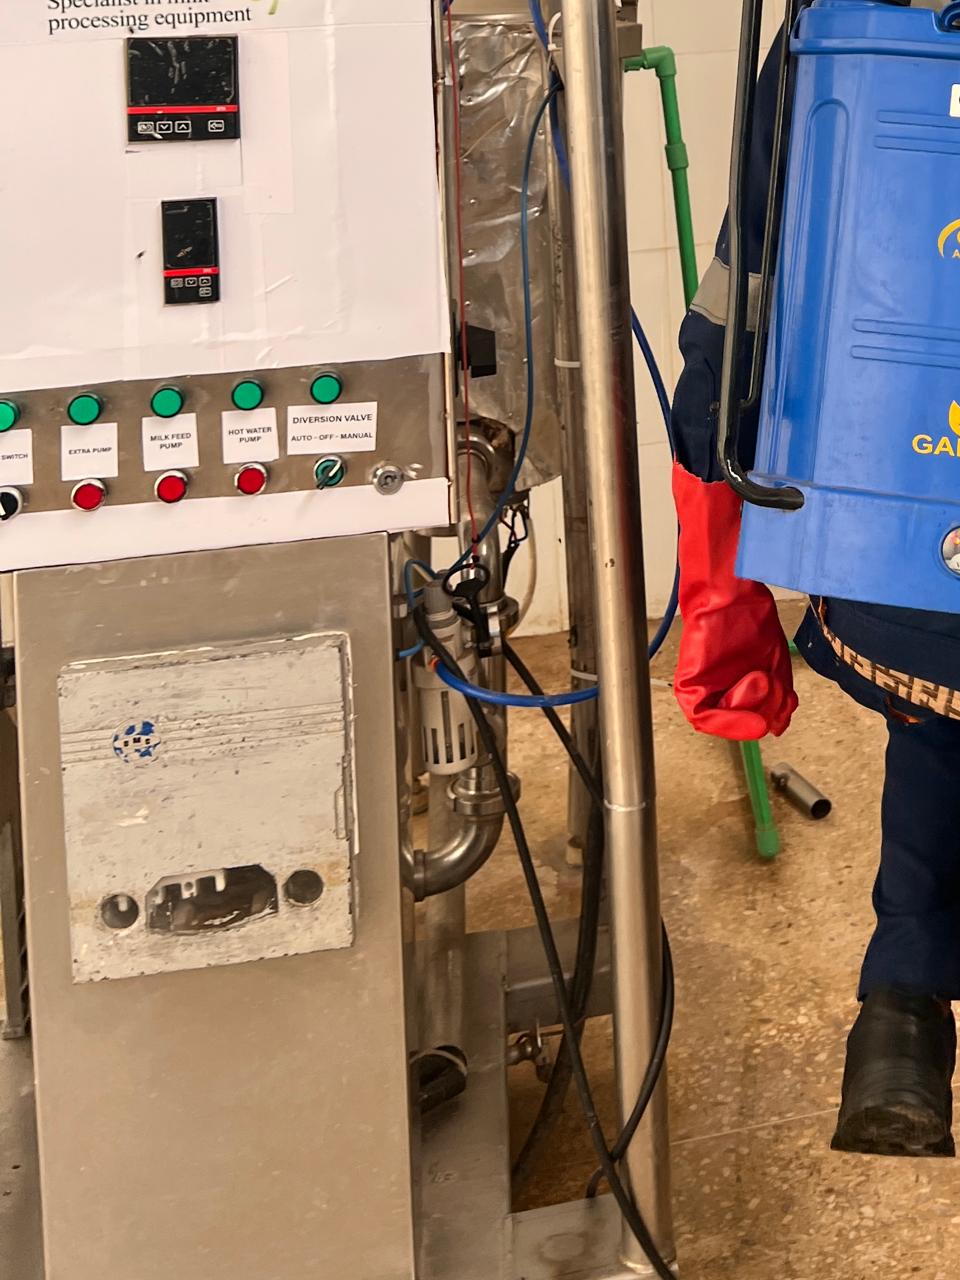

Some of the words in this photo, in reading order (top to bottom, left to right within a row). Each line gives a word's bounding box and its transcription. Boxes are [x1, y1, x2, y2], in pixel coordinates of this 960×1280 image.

[48, 10, 149, 35] processing
[155, 7, 252, 29] equipment
[292, 415, 342, 424] DIVERSION
[344, 413, 373, 422] VALVE
[171, 432, 192, 440] FEED
[245, 427, 272, 435] WATER
[291, 434, 312, 442] AUTO
[340, 432, 373, 440] MANUAL
